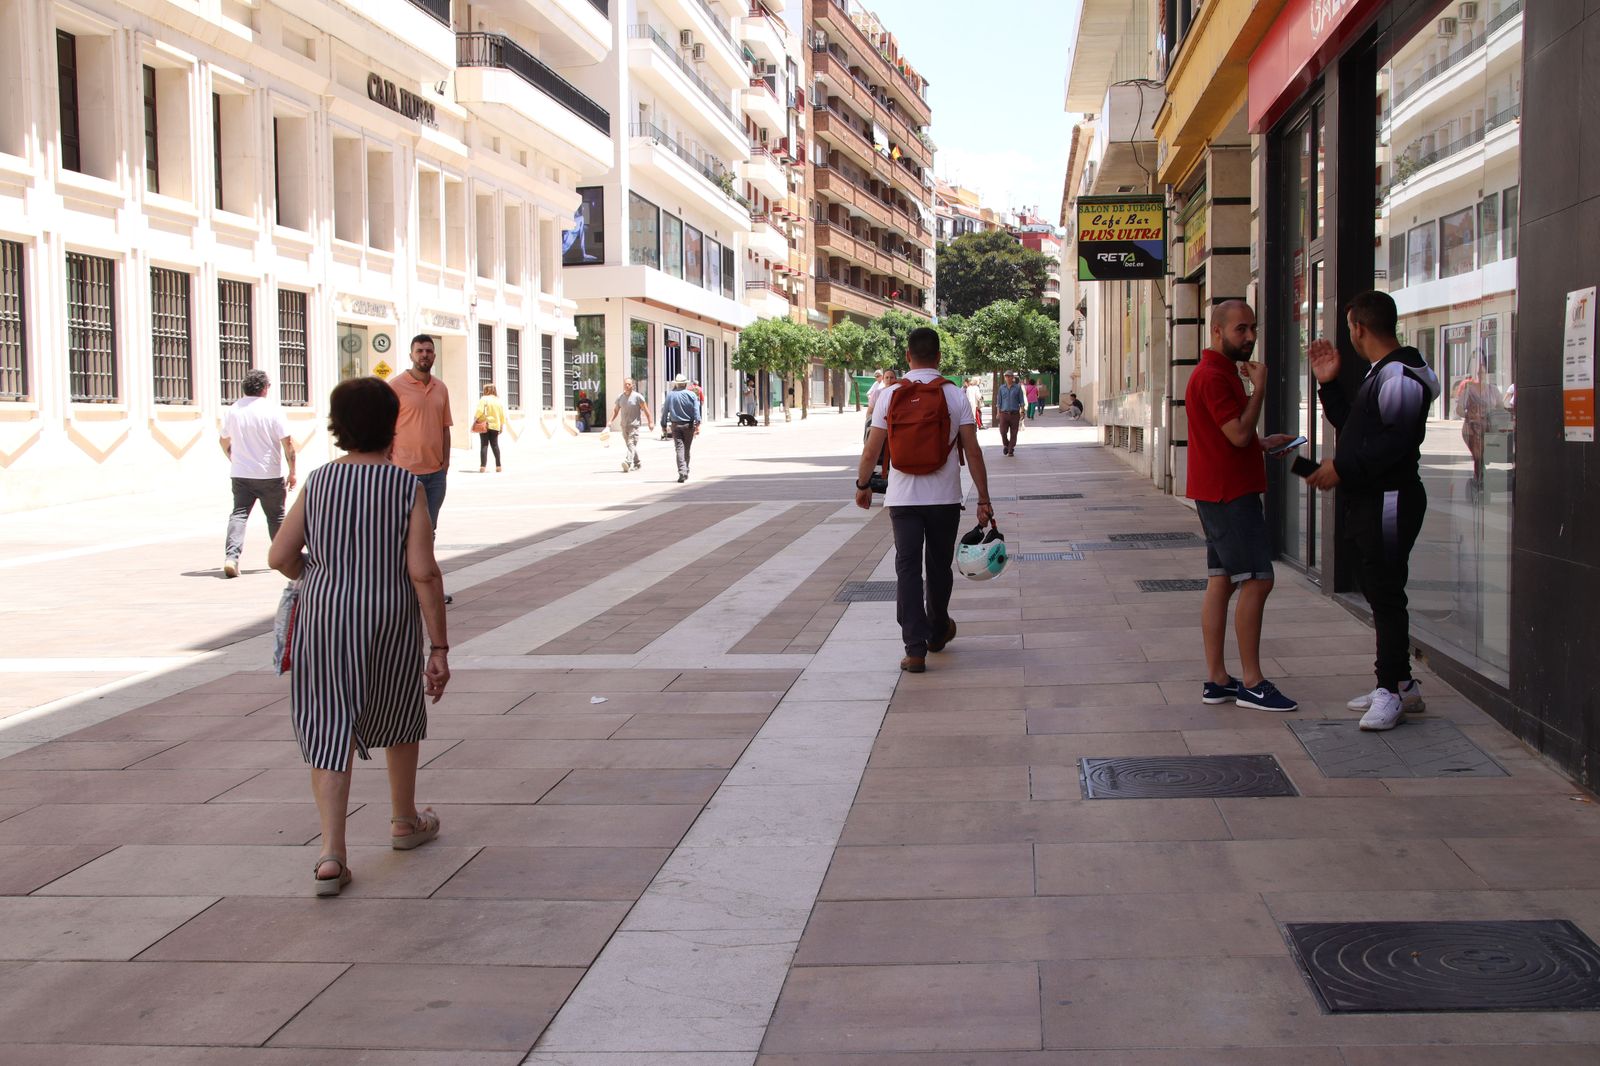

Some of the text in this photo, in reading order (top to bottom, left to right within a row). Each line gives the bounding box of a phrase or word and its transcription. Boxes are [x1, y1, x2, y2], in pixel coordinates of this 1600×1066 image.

[1079, 204, 1162, 213] SALON DE JUEGOS
[1126, 213, 1149, 224] Bar
[1080, 227, 1161, 240] PLUS ULTRA
[572, 352, 598, 364] alth
